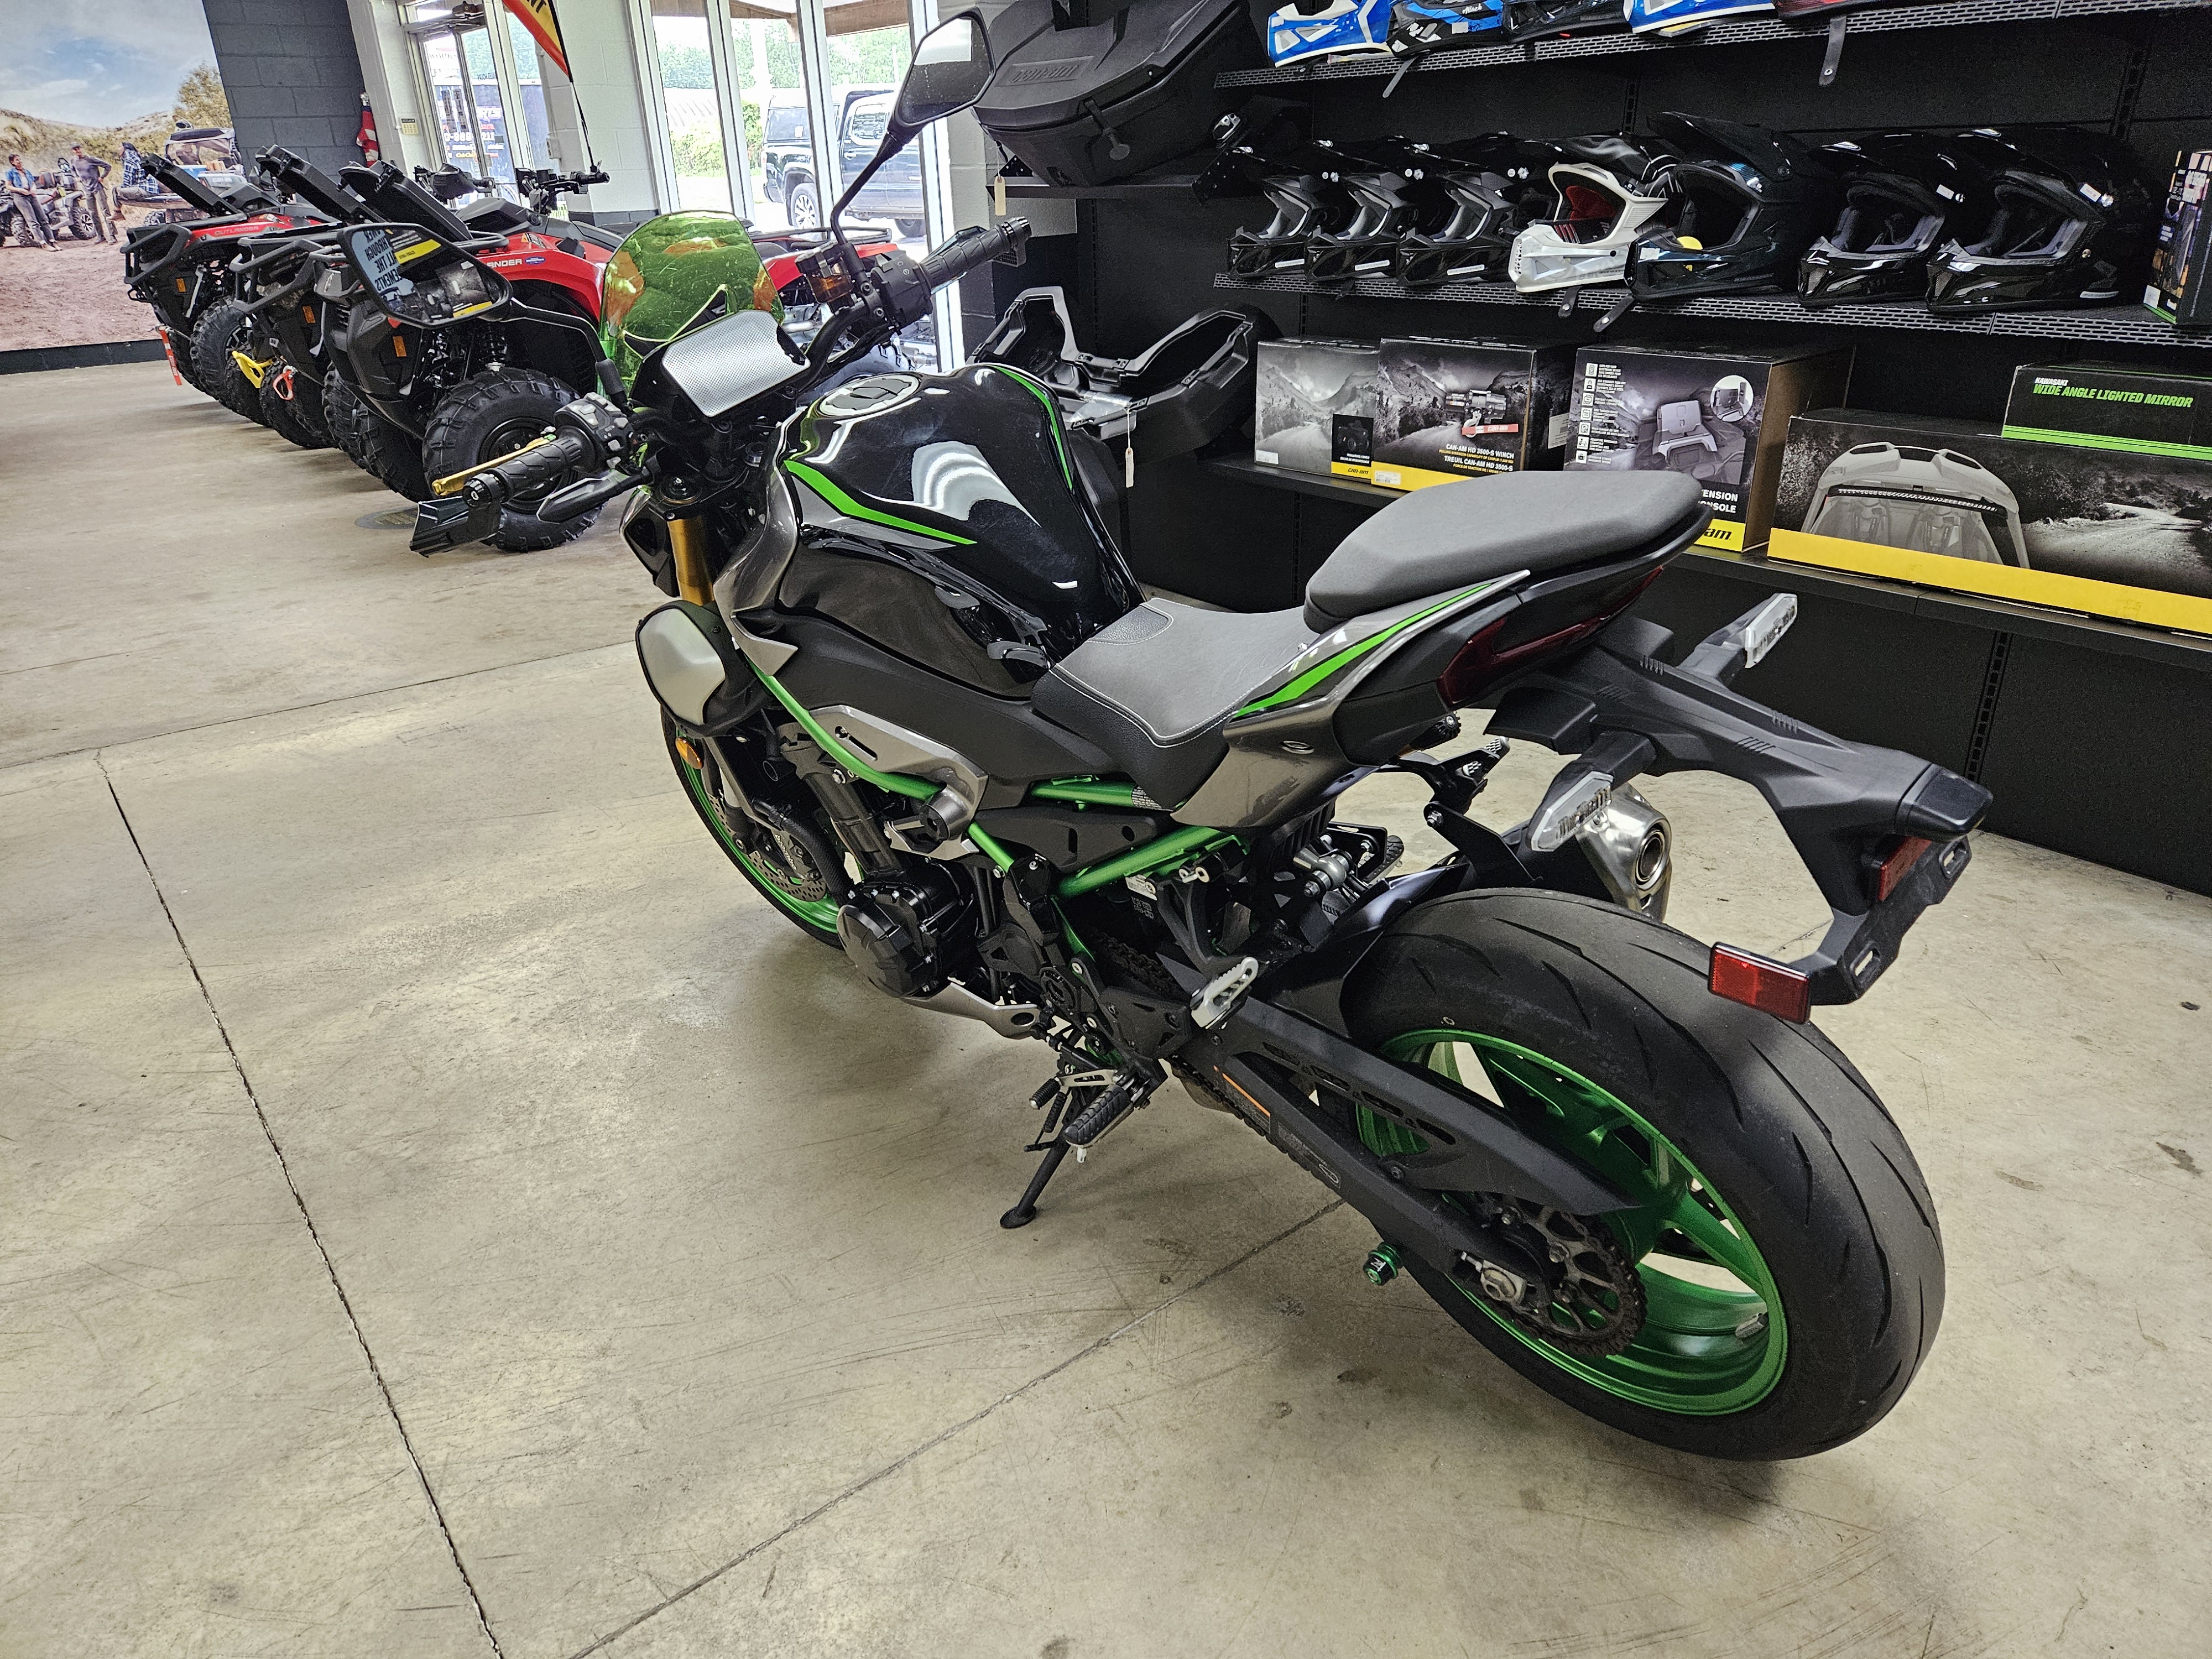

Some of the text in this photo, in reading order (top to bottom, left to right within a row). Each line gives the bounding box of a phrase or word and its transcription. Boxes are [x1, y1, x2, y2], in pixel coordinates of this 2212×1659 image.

[215, 226, 259, 236] OUTLANDER
[2034, 377, 2069, 387] KAWASAKI
[2033, 384, 2194, 408] WIDE ANGLE LIGHTED MIRROR
[1446, 444, 1467, 452] CAN-AM
[1477, 448, 1495, 456] 3500-S
[1495, 451, 1514, 460] WINCH
[1444, 455, 1463, 464] TREUIL
[1464, 458, 1485, 467] CAN-AM
[1495, 463, 1514, 472] 3500-S
[1701, 489, 1738, 502] ENSION
